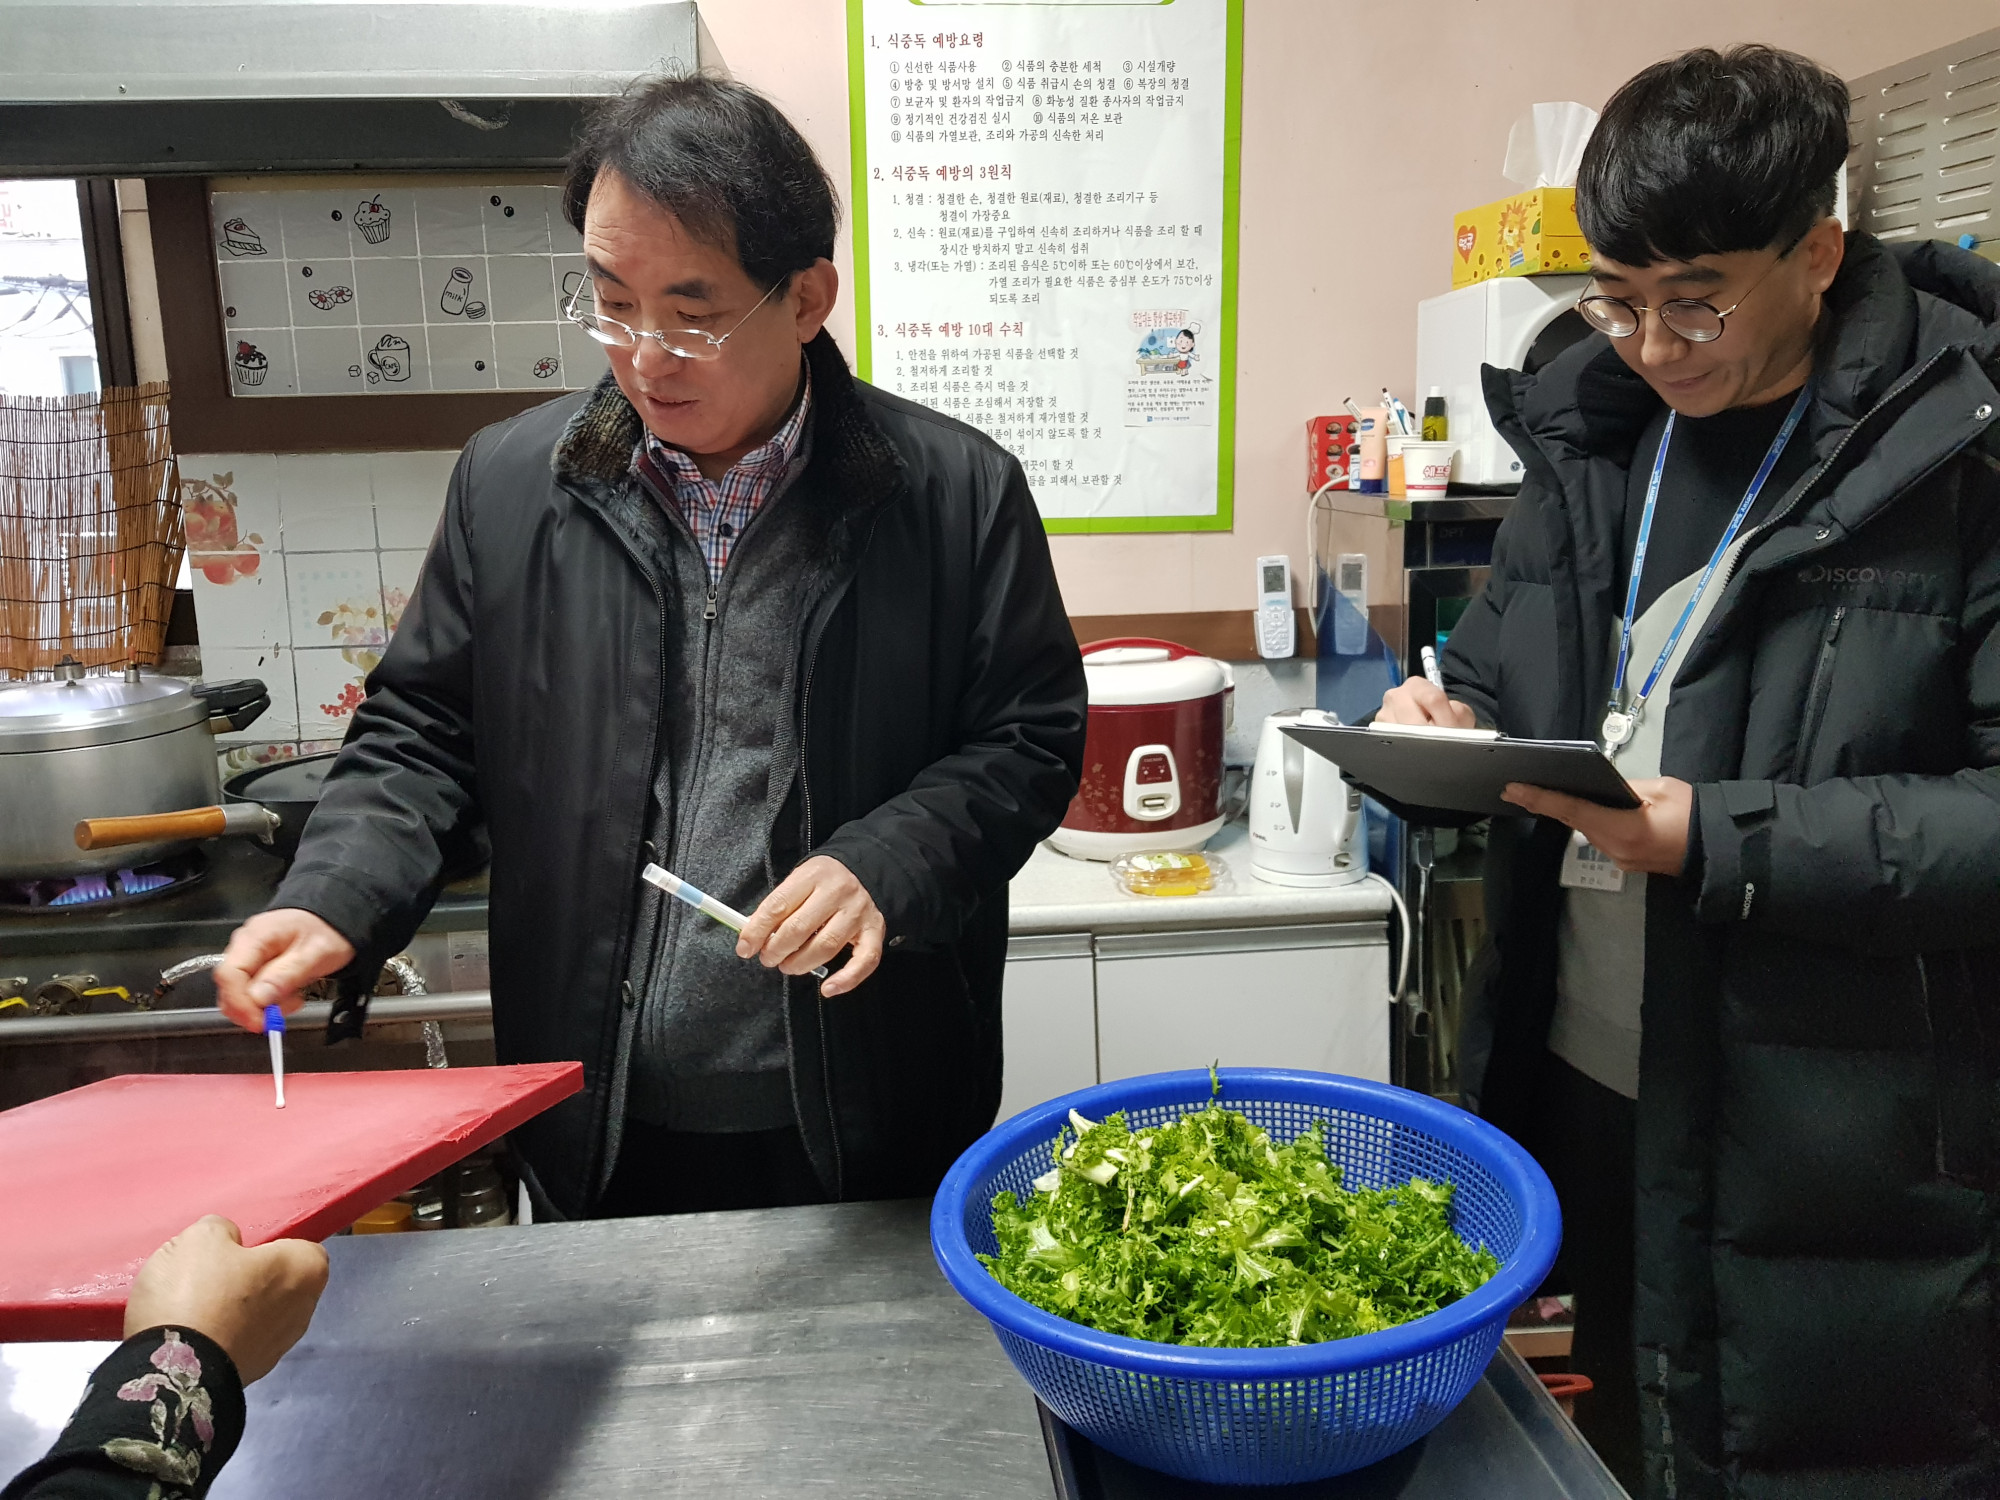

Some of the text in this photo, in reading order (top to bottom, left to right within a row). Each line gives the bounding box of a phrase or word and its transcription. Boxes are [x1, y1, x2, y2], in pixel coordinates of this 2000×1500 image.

[870, 31, 984, 50] 1. 식중독 예방요령
[904, 60, 934, 74] 신선한
[937, 59, 978, 74] 식품사용
[1015, 59, 1045, 73] 식품의
[1048, 59, 1079, 74] 충분한
[1081, 59, 1102, 74] 세척
[1136, 59, 1177, 74] 시설개량
[928, 78, 938, 92] 및
[941, 77, 972, 92] 방서망
[976, 77, 993, 90] 설치
[1016, 76, 1037, 90] 식품
[1039, 76, 1069, 92] 취급시
[1072, 77, 1092, 91] 손의
[1096, 77, 1116, 91] 청결
[1136, 76, 1167, 91] 복장의
[1170, 77, 1190, 91] 청결
[904, 95, 935, 109] 보균자
[938, 95, 948, 109] 및
[951, 94, 981, 109] 환자의
[985, 94, 1023, 107] 작업금지
[1045, 93, 1075, 108] 화농성
[1078, 94, 1100, 108] 질환
[1101, 94, 1141, 108] 종사자의
[1144, 93, 1184, 108] 작업금지
[905, 112, 944, 126] 정기적인
[948, 111, 988, 126] 건강검진
[991, 110, 1011, 125] 실시
[1046, 111, 1076, 125] 식품의
[1079, 111, 1100, 126] 저온
[1102, 111, 1124, 125] 보관
[905, 129, 934, 143] 식품의
[985, 128, 1016, 142] 조리와
[1018, 128, 1048, 142] 가공의
[1051, 128, 1082, 142] 신속한
[1084, 128, 1104, 142] 처리
[873, 163, 1012, 182] 2. 식중독 예방의 3원칙
[892, 194, 901, 206] 1.
[905, 192, 924, 206] 청결
[936, 192, 966, 206] 청결한
[986, 191, 1017, 205] 청결한
[1073, 191, 1103, 205] 청결한
[1105, 191, 1146, 205] 조리기구
[1148, 191, 1159, 204] 등
[939, 208, 1011, 223] 청결이 가장중요
[893, 224, 1203, 240] 2. 신속 원료(재료)를 구입하여 신속히 조리하거나 식품을 조리 할 때
[938, 241, 1089, 256] 장시간 방치하지 말고 신속히 섭취
[893, 261, 903, 273] 3.
[907, 259, 951, 273] 냉각(또는
[953, 259, 977, 273] 가열)
[987, 258, 1017, 272] 조리된
[1020, 258, 1050, 272] 음식은
[1052, 258, 1088, 272] 5℃이하
[1090, 259, 1111, 272] 또는
[1113, 257, 1172, 271] 60℃이상에서
[988, 274, 1213, 289] 가열 조리가 필요한 식품은 중심부 온도가 75℃이상
[444, 290, 464, 303] milk
[989, 291, 1041, 306] 되도록 조리
[877, 321, 1024, 339] 3. 식중독 예방 10대 수칙
[896, 346, 1079, 361] 1. 안전을 위하여 가공된 식품을 선택할 것
[895, 363, 993, 378] 2. 철저하게 조리할 것
[897, 379, 1029, 394] 3. 조리된 식품은 즉시 먹을 것
[942, 396, 972, 409] 식품은
[974, 395, 1012, 409] 조심해서
[1015, 395, 1045, 409] 저장할
[1048, 395, 1057, 408] 것
[966, 413, 994, 425] 식품은
[997, 411, 1035, 425] 철저하게
[1038, 411, 1077, 425] 재가열할
[1079, 411, 1089, 424] 것
[1016, 427, 1044, 441] 섞이지
[1047, 427, 1077, 440] 않도록
[1079, 426, 1090, 440] 할
[1092, 426, 1102, 440] 것
[1051, 458, 1062, 471] 할
[1064, 458, 1074, 472] 것
[1049, 474, 1078, 487] 피해서
[1080, 473, 1110, 487] 보관할
[1113, 473, 1122, 487] 것
